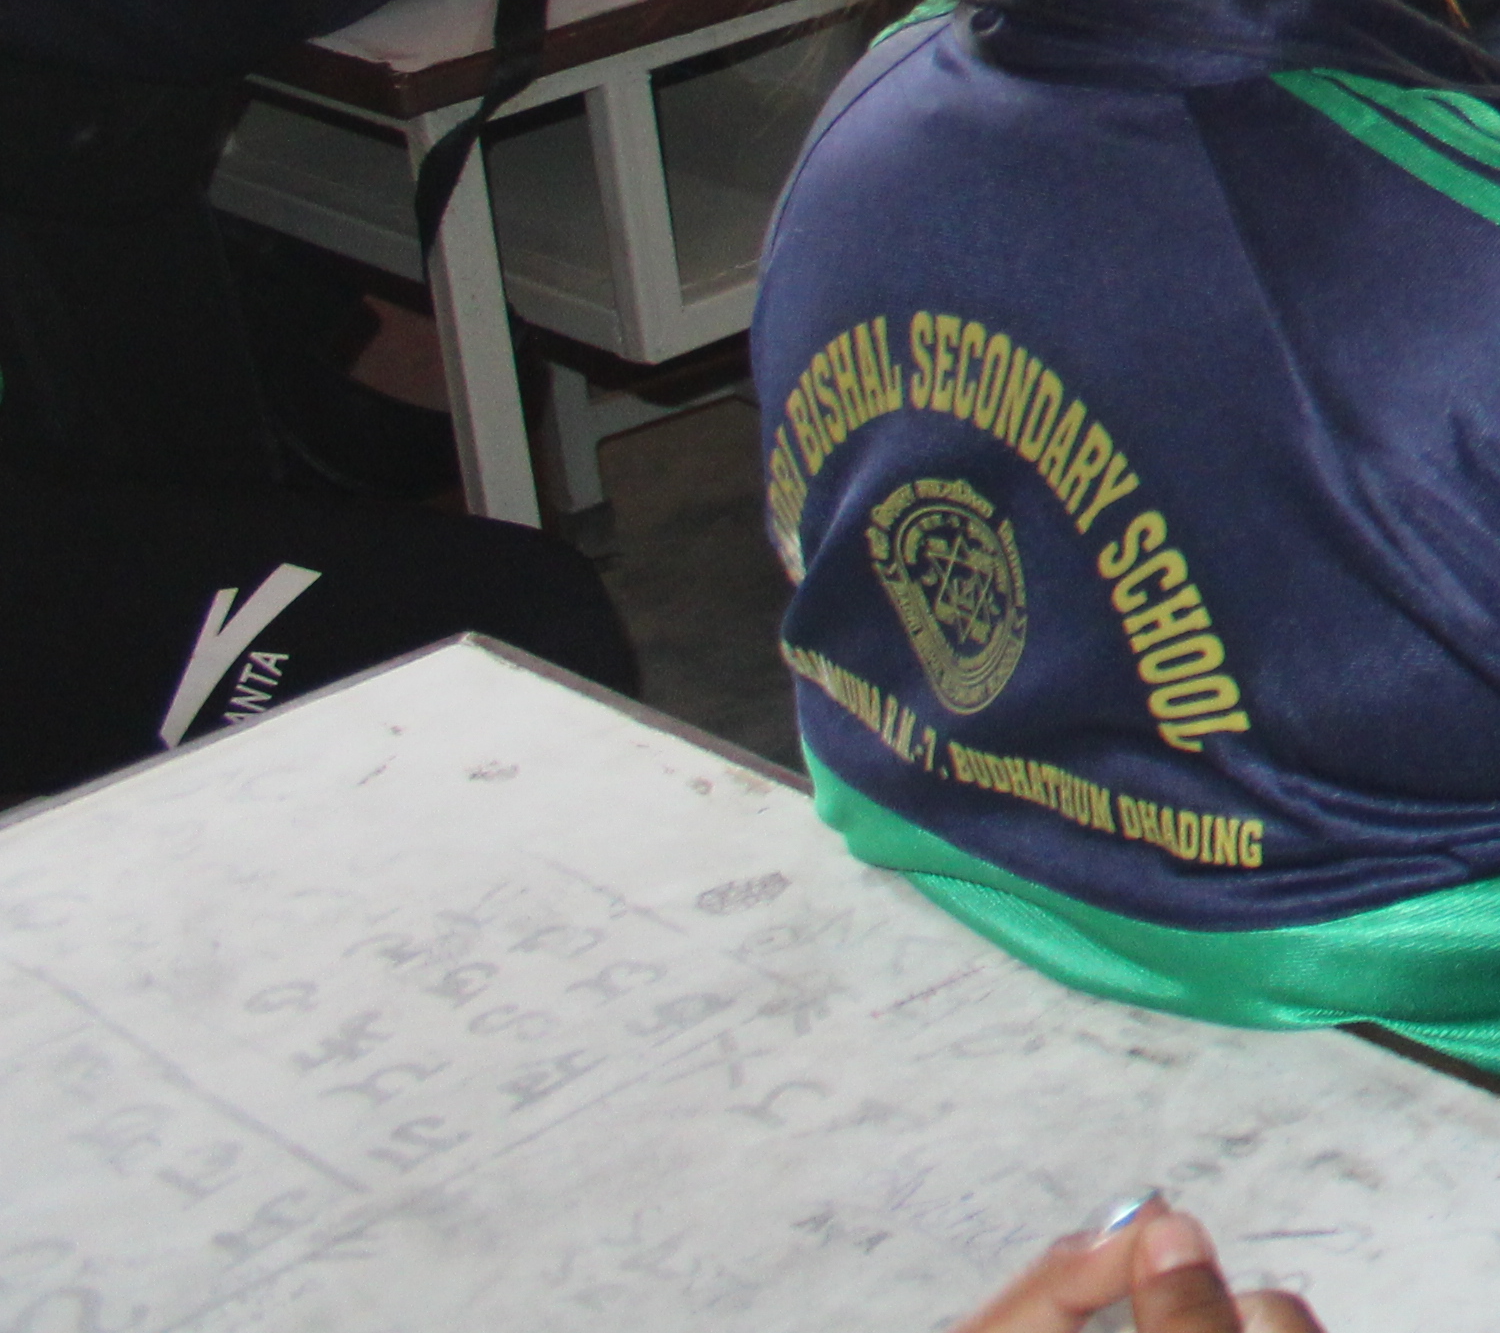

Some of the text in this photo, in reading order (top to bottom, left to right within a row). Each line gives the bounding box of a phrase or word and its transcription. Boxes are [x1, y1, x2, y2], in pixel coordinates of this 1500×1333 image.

[785, 315, 903, 477] BISHAL
[908, 310, 1142, 534] SECONDARY
[1098, 509, 1251, 753] SCHOOL
[1118, 794, 1264, 869] DHADING
